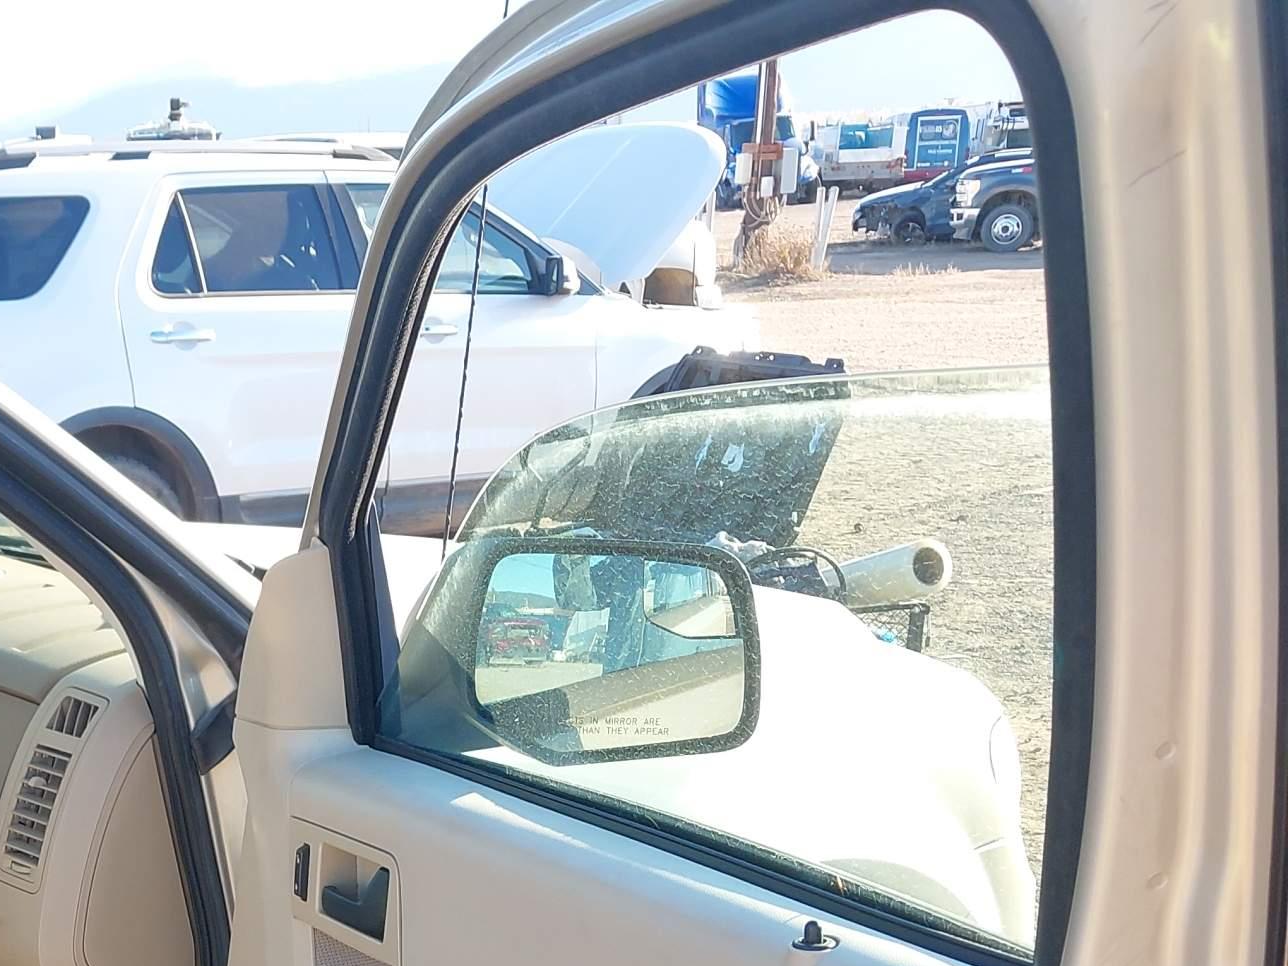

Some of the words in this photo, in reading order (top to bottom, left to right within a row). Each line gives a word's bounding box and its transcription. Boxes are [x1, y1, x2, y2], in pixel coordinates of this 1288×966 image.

[590, 716, 599, 725] IN
[605, 717, 638, 726] MIRROR
[644, 717, 662, 726] ARE
[606, 726, 628, 735] THEY
[634, 727, 670, 736] APPEAR
